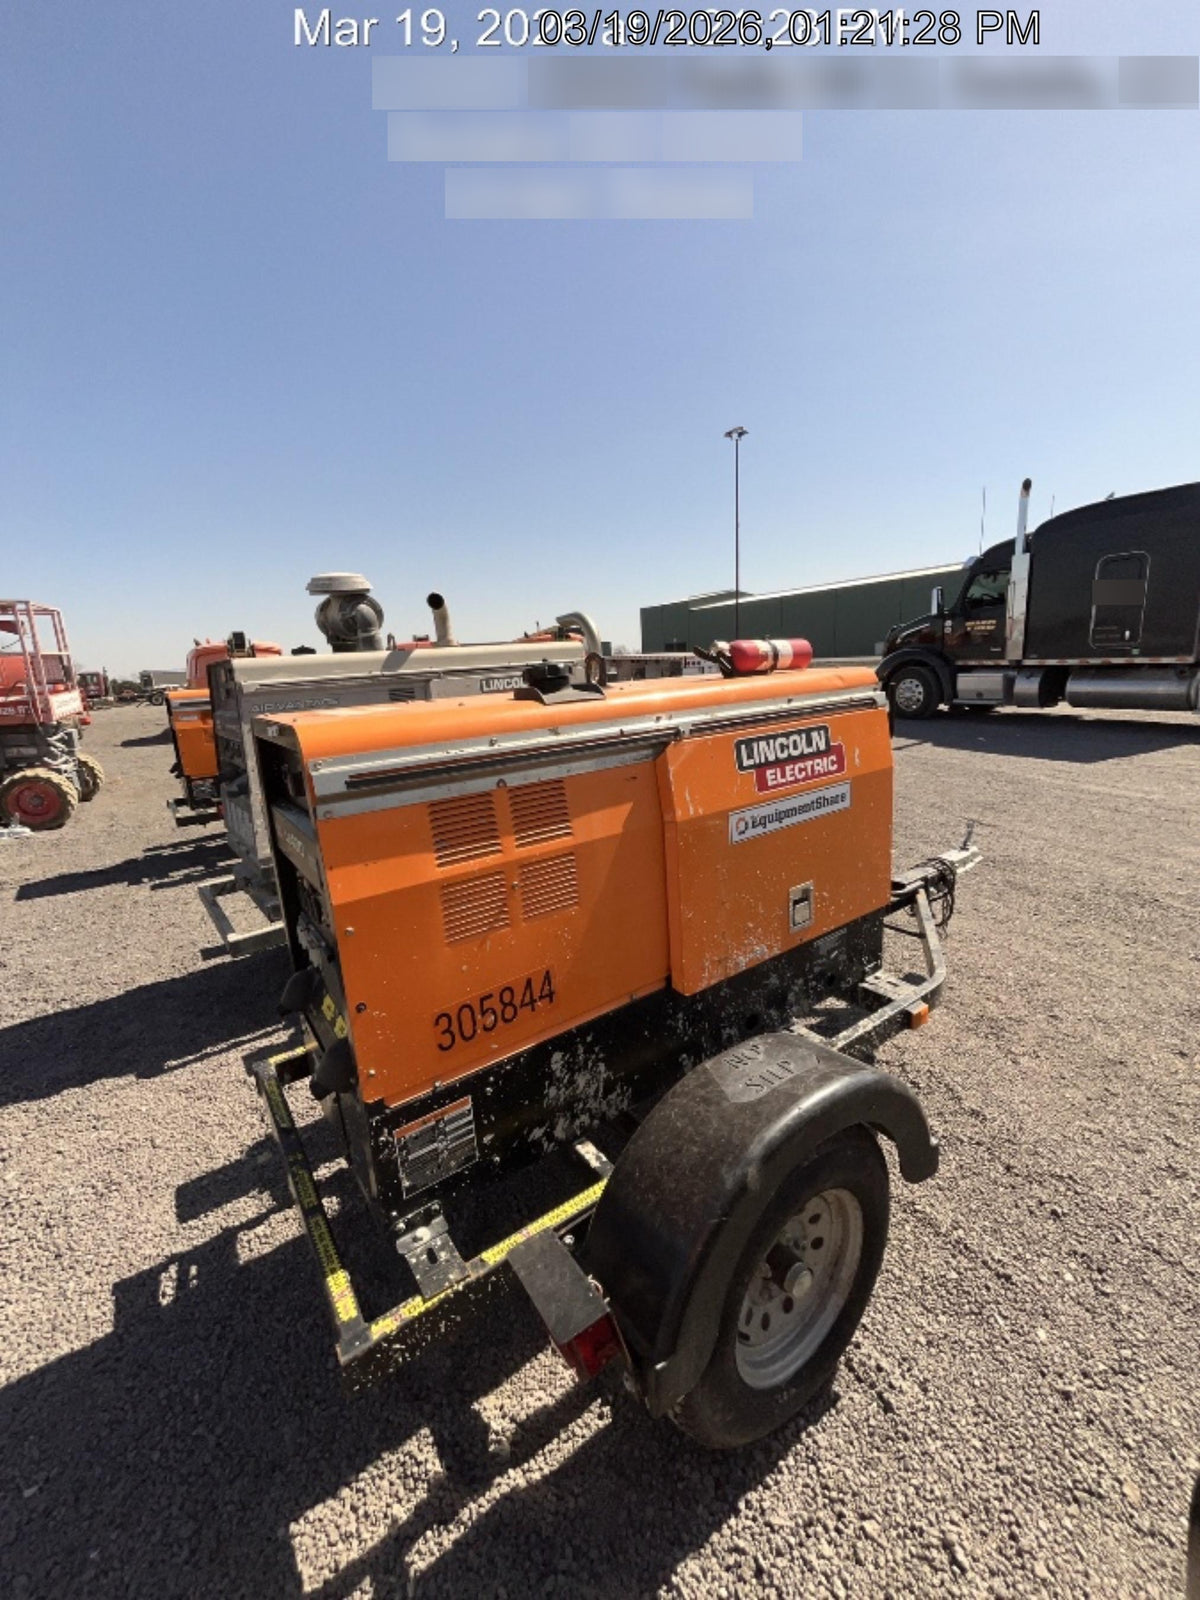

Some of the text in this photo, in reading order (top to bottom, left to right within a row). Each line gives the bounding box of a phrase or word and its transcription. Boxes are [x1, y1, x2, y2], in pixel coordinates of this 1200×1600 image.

[481, 677, 529, 693] LINCOL
[740, 729, 827, 768] LINCOLN
[765, 754, 839, 787] ELECTRIC
[750, 791, 848, 830] EquipmentShare
[434, 969, 556, 1052] 305844
